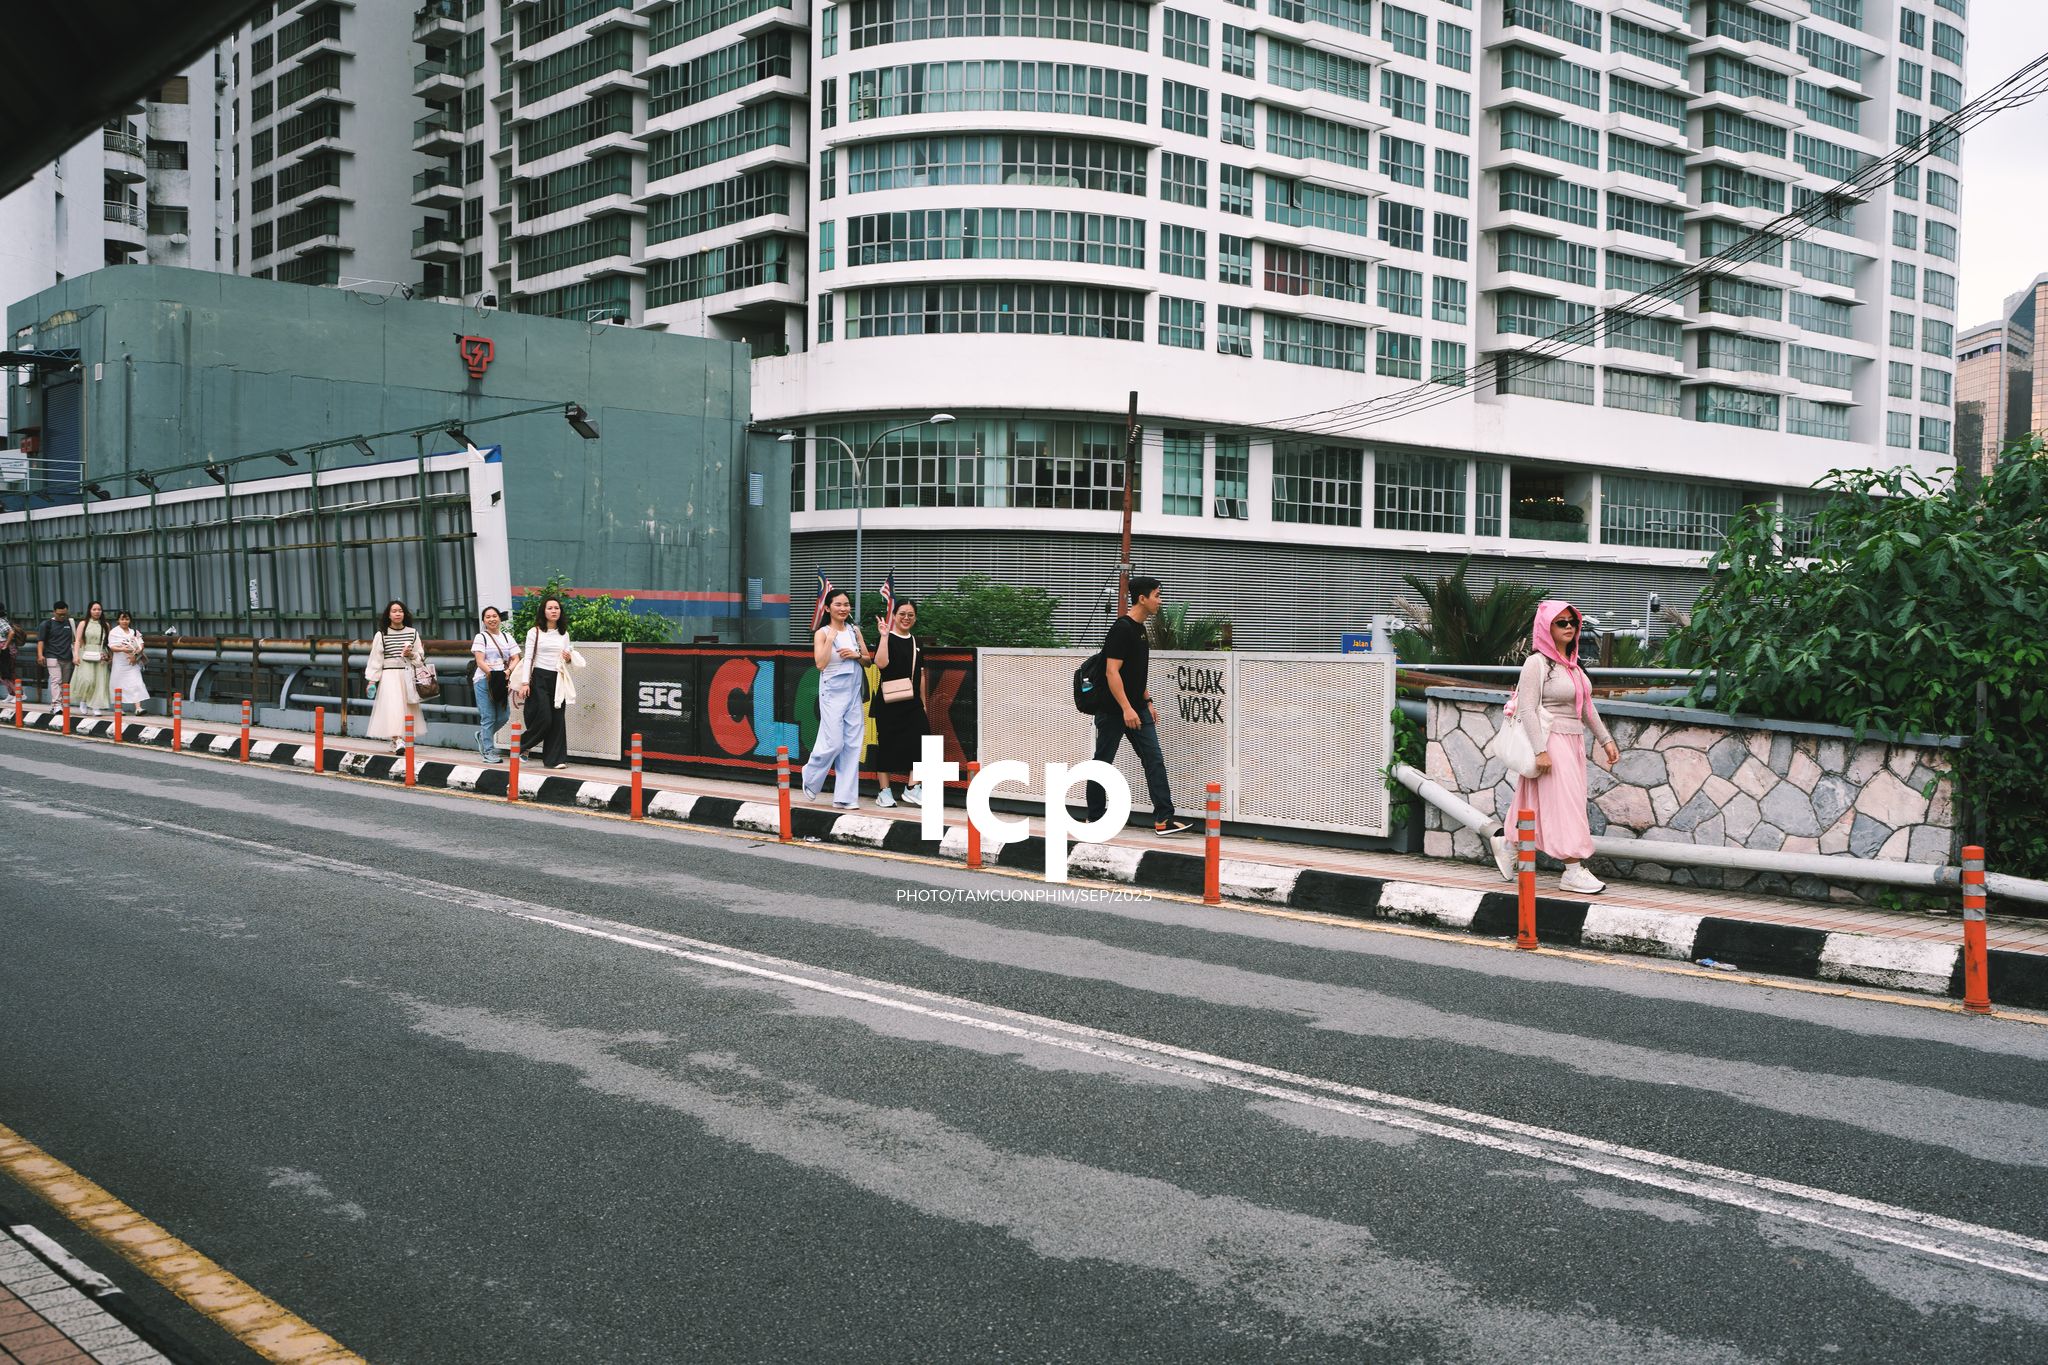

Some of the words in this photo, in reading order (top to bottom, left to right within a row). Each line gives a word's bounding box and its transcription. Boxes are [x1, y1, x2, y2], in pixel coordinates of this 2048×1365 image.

[1352, 639, 1369, 648] Jalan
[1177, 665, 1226, 695] CLOAK
[638, 686, 683, 710] SFC
[1177, 694, 1225, 724] WORK
